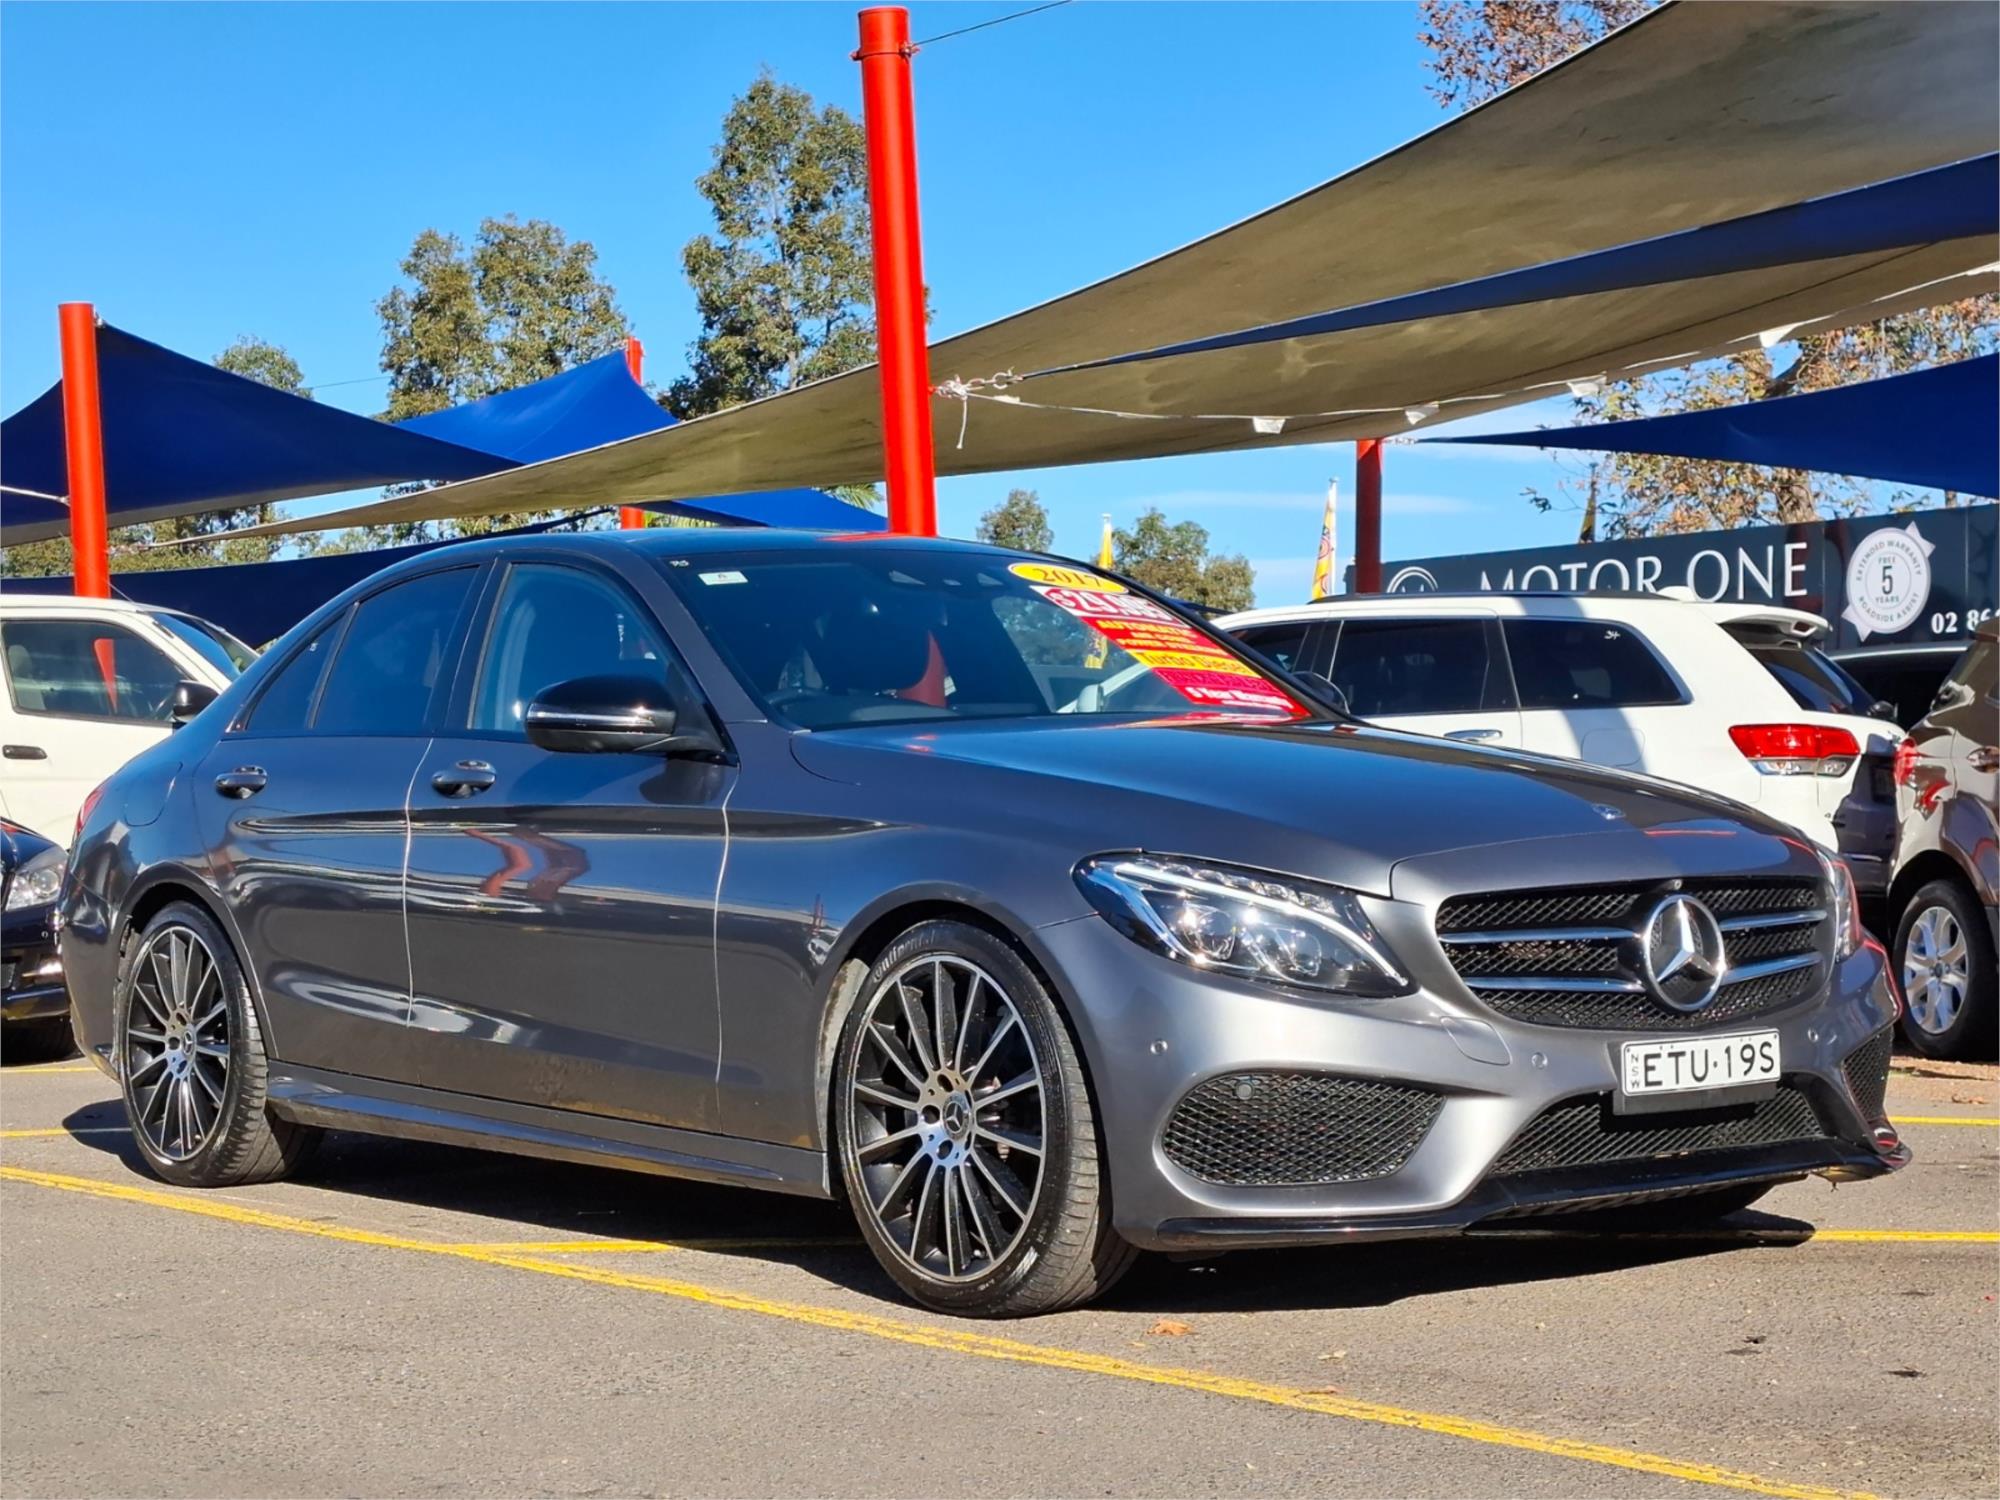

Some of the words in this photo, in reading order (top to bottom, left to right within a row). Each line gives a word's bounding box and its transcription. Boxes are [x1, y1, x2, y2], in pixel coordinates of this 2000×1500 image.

[1878, 556, 1896, 564] FREE
[1887, 540, 1922, 575] WARRANTY
[1033, 568, 1100, 587] 2017
[1686, 542, 1808, 602] ONE
[1882, 565, 1893, 595] 5
[1859, 595, 1894, 622] ROADSIDE
[1896, 592, 1920, 619] ASSIST
[1875, 595, 1900, 604] YEARS
[1931, 612, 1958, 634] 02
[1966, 607, 2000, 631] 86
[1134, 651, 1188, 667] Turbo
